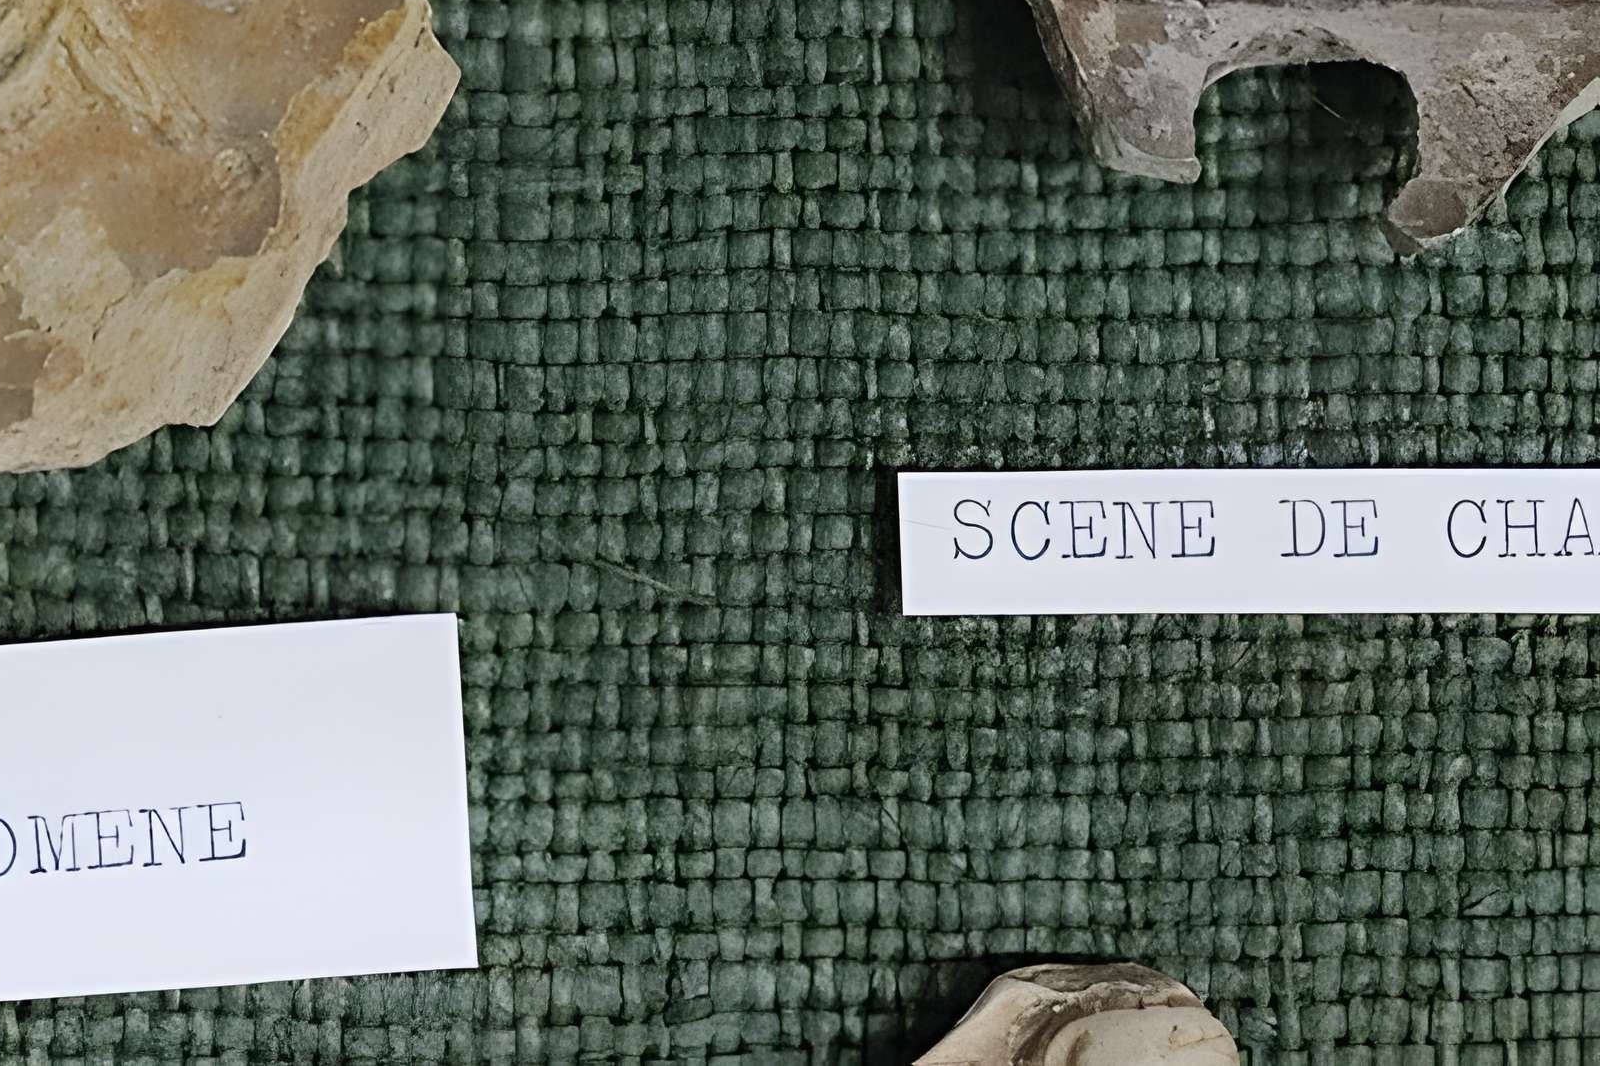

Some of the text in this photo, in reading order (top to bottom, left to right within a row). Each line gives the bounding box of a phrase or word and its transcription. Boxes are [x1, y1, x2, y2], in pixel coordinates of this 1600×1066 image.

[952, 496, 1600, 561] SCENE DE CHA
